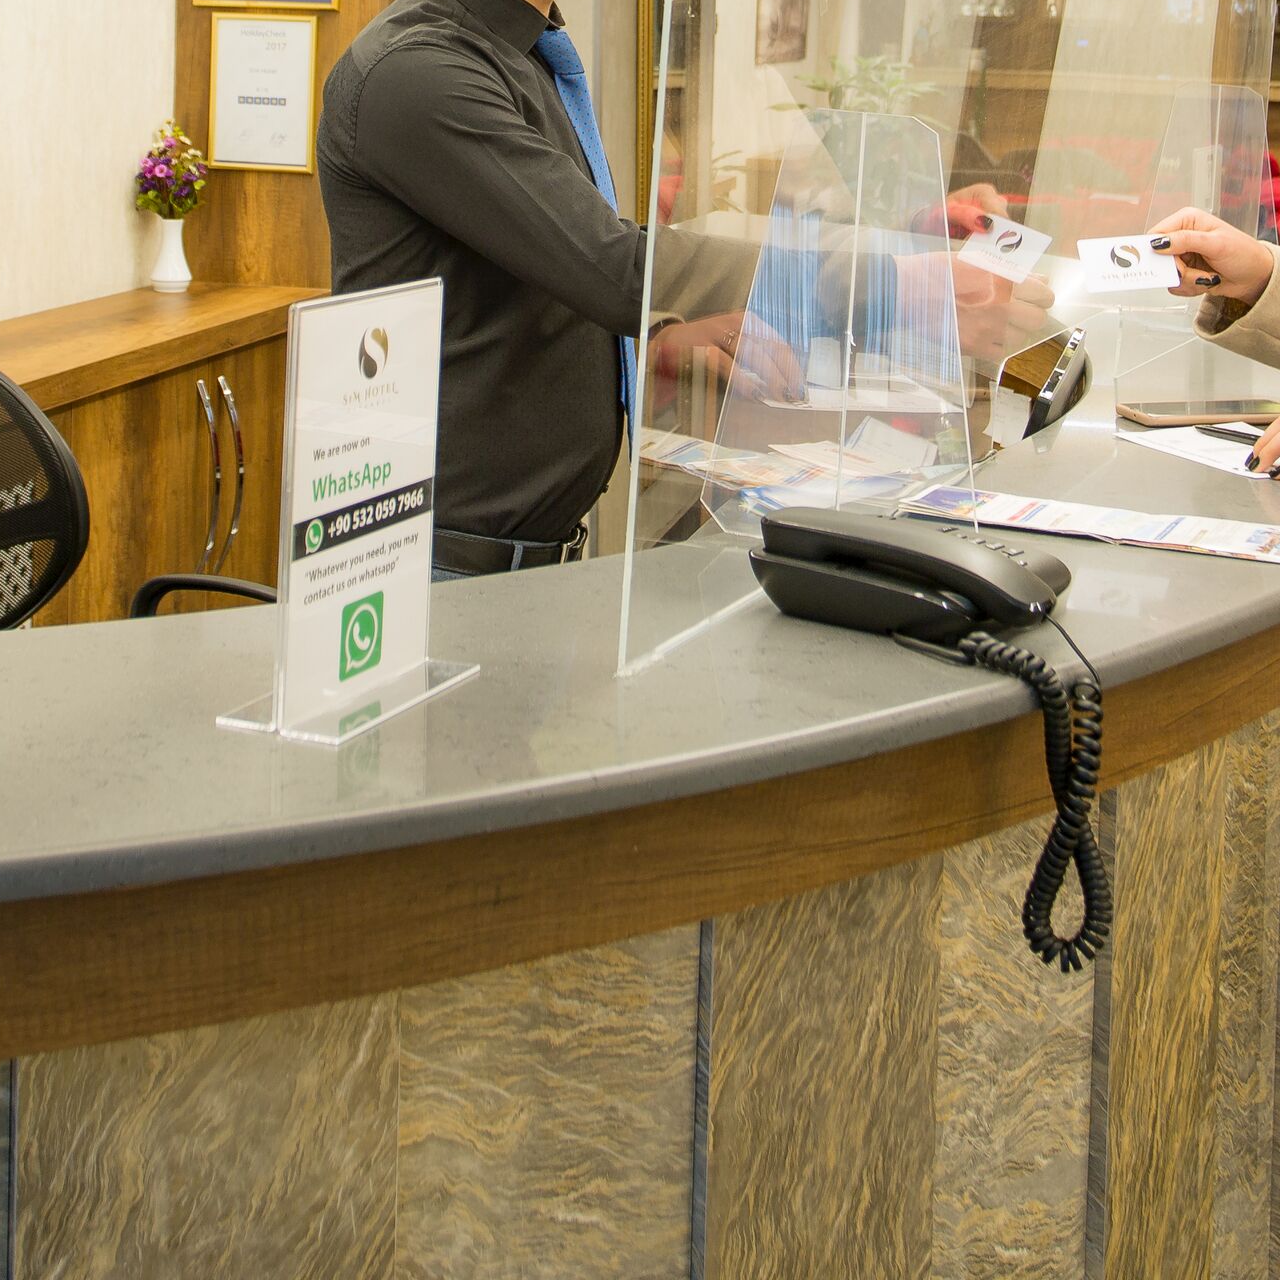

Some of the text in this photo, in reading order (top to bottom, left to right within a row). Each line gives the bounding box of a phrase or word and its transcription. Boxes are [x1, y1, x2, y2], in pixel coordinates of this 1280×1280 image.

[265, 41, 287, 51] 2017
[365, 381, 398, 401] HOTEL
[313, 436, 370, 461] We are now on
[312, 461, 392, 502] WhatsApp
[328, 487, 424, 538] +90 532 059 7966
[350, 555, 364, 570] you
[366, 543, 386, 560] need,
[388, 540, 402, 555] you
[403, 532, 419, 546] may
[303, 585, 335, 605] contact
[336, 580, 345, 591] us
[347, 577, 357, 588] on
